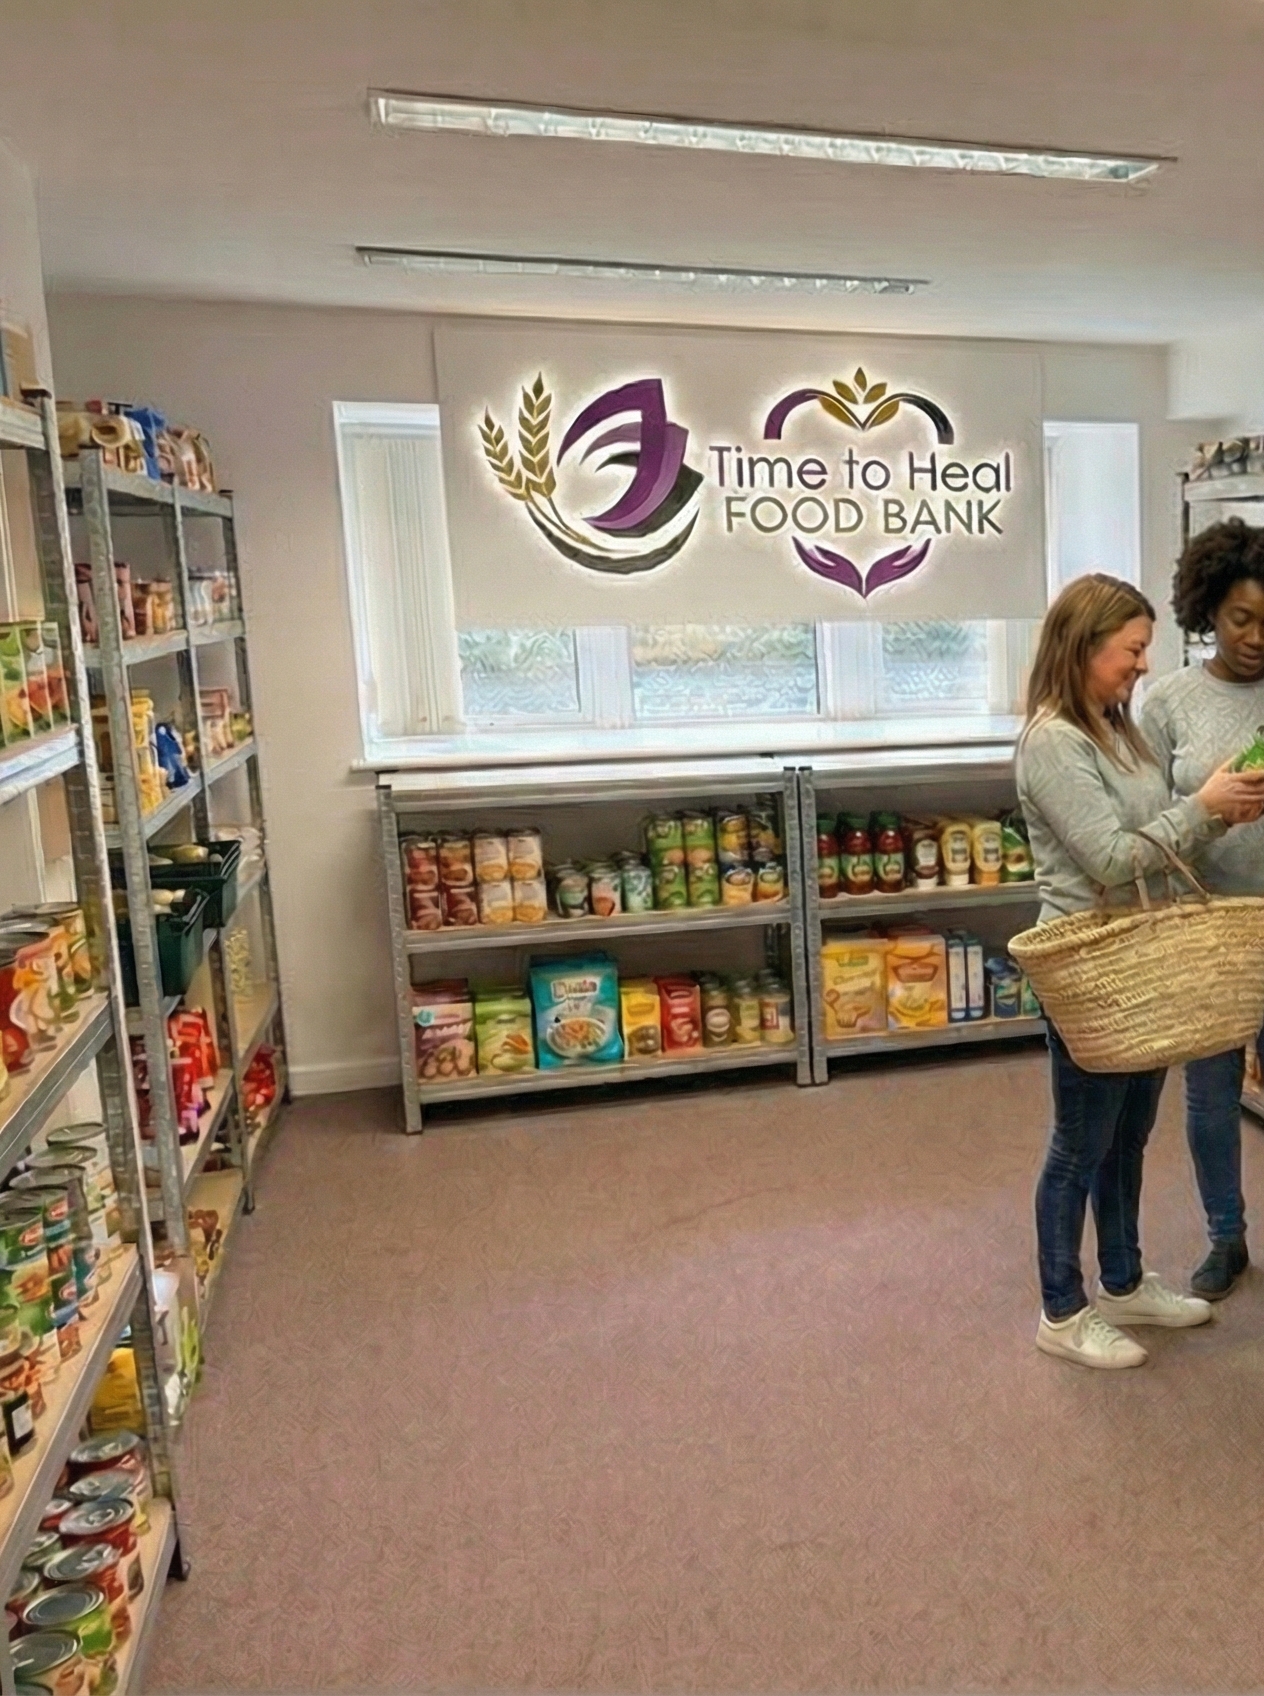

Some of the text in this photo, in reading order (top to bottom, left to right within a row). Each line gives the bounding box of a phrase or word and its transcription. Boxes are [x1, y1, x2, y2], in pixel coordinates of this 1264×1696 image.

[709, 446, 1011, 493] Time to Heal
[725, 496, 1003, 534] FOOD BANK
